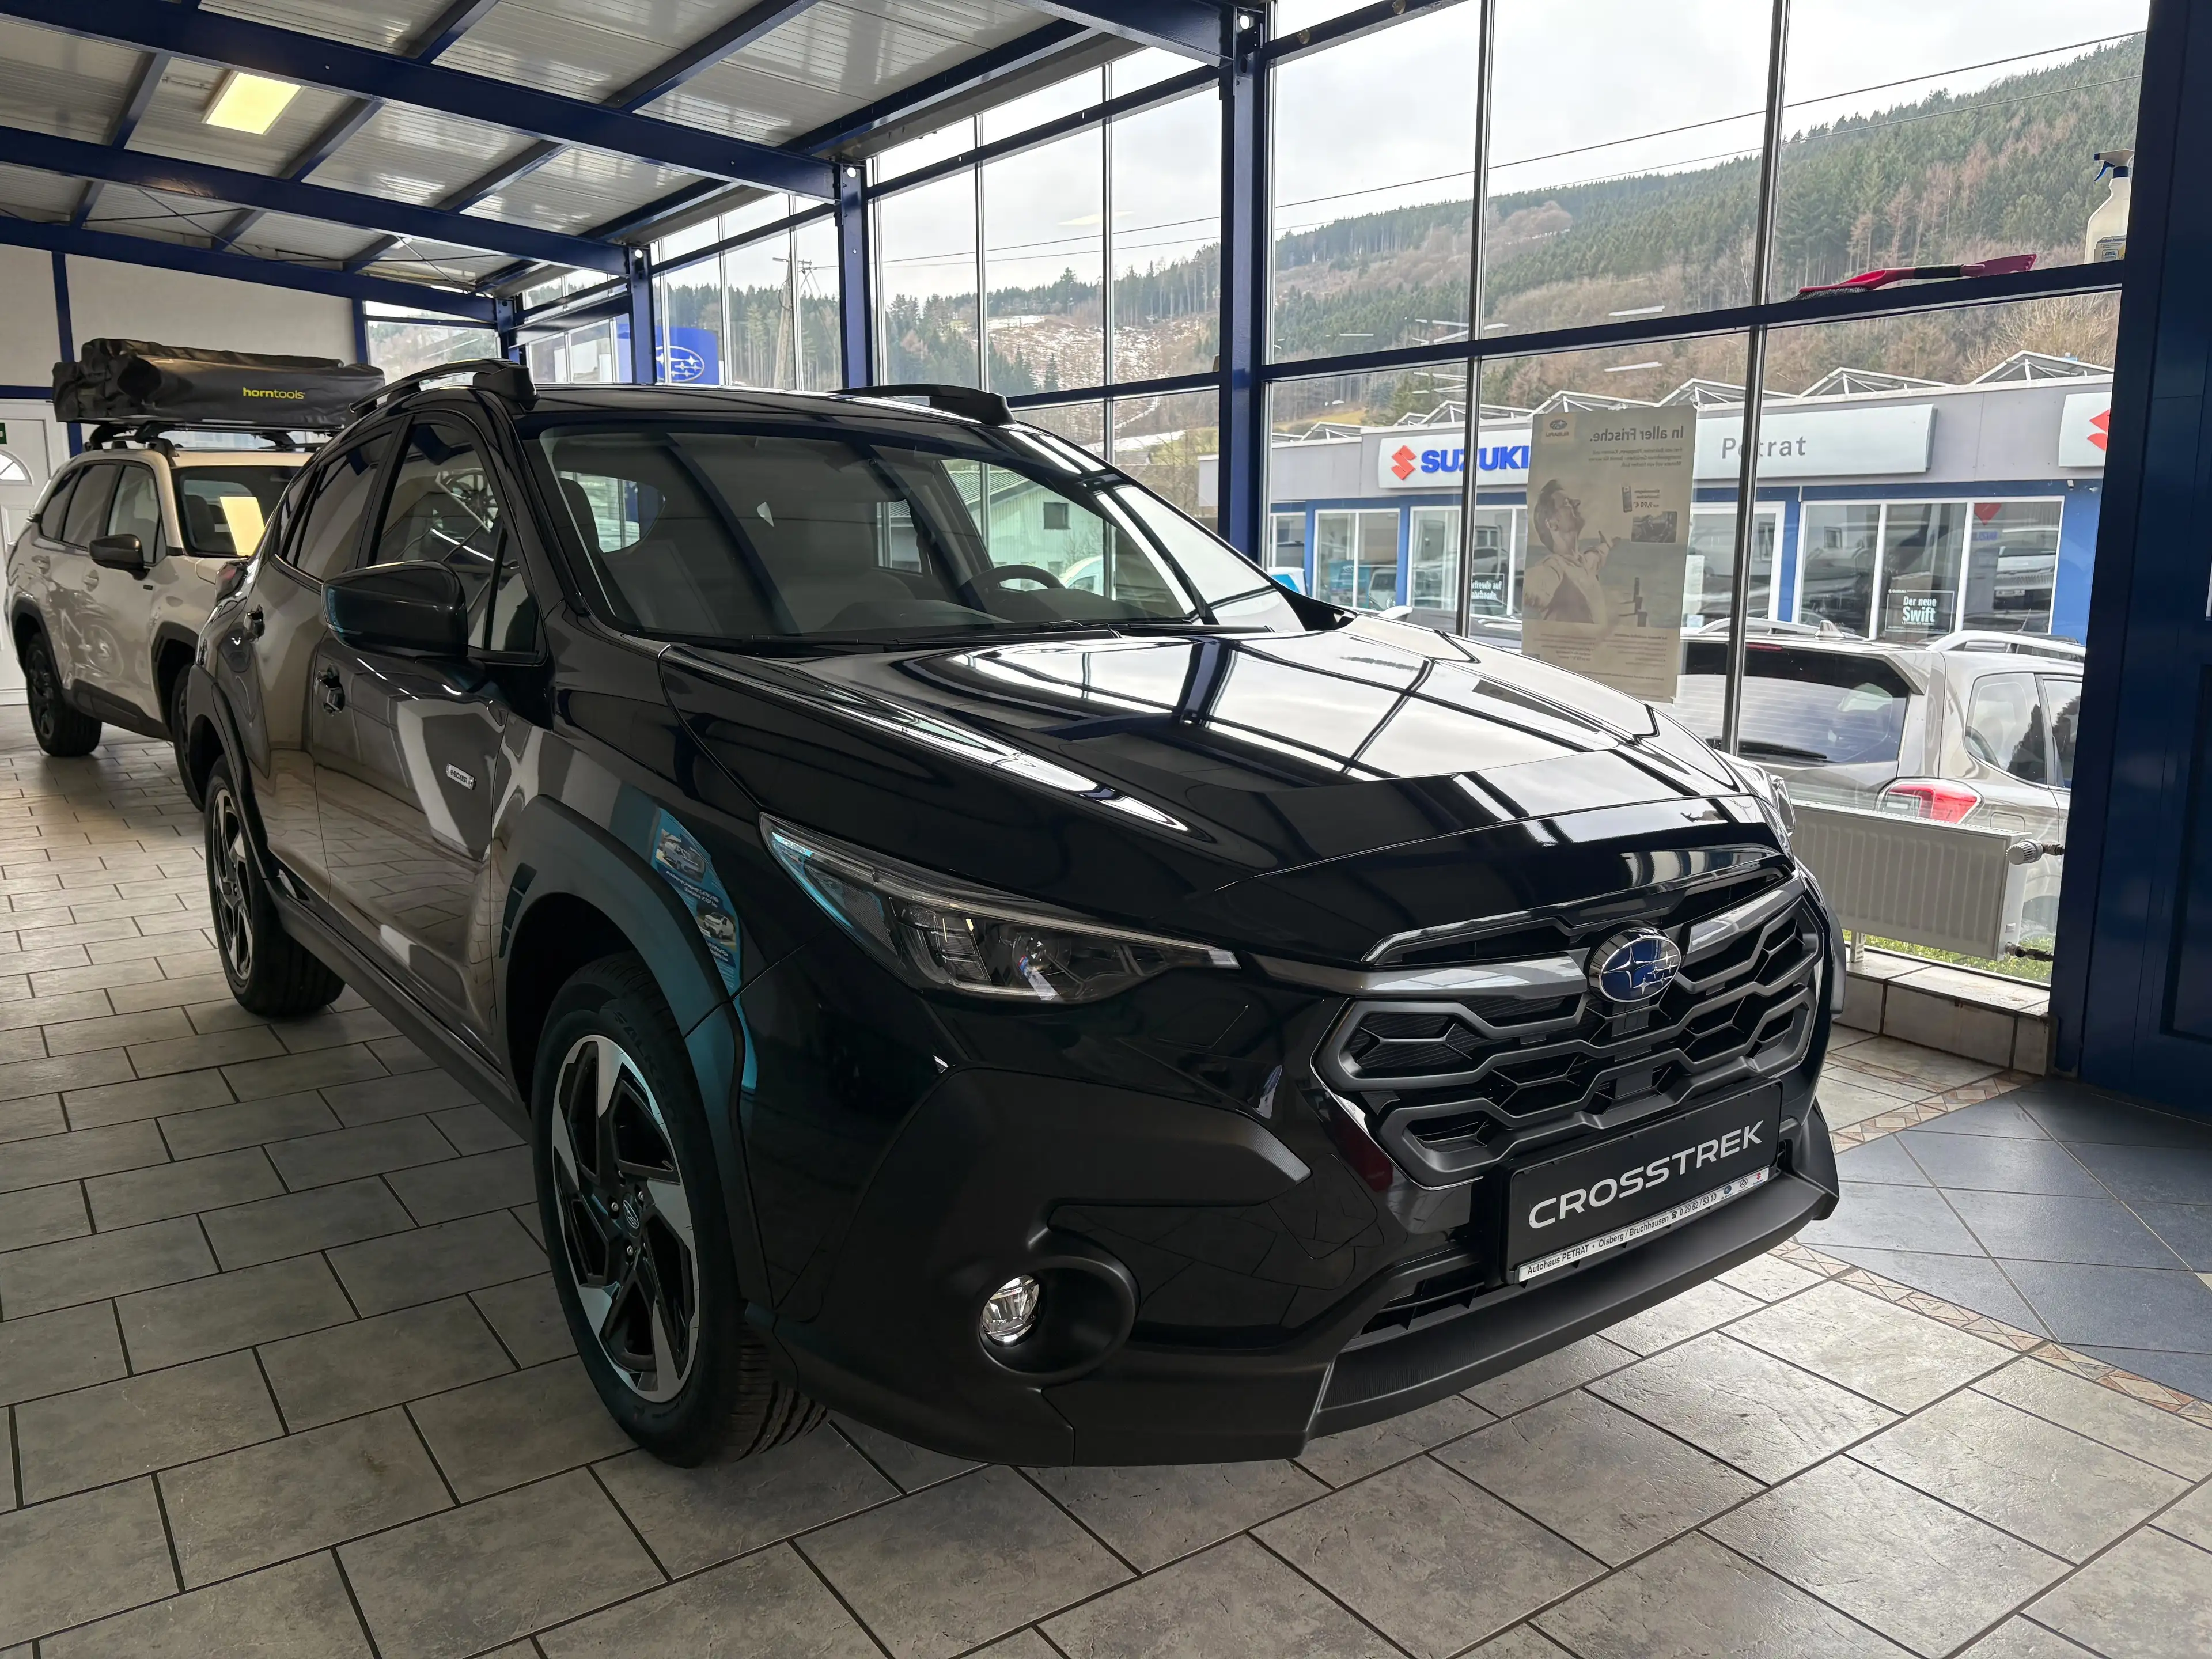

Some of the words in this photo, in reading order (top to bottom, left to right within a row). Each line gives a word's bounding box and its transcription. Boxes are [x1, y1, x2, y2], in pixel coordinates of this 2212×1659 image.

[243, 387, 305, 399] horntools
[1722, 436, 1806, 459] Ptrat
[1903, 596, 1916, 606] Der
[1918, 598, 1937, 607] neue
[1902, 605, 1936, 622] Swift
[1528, 1120, 1764, 1229] CROSSTREK
[1527, 1257, 1560, 1275] Autohaus
[1562, 1244, 1590, 1262] PETRAT
[1599, 1233, 1624, 1248] Olsberg
[1629, 1215, 1669, 1237] Bruchhausen
[1679, 1208, 1683, 1216] 0
[1684, 1205, 1691, 1214] 29
[1692, 1201, 1699, 1210] 62
[1703, 1196, 1709, 1206] 53
[1711, 1192, 1717, 1202] 10
